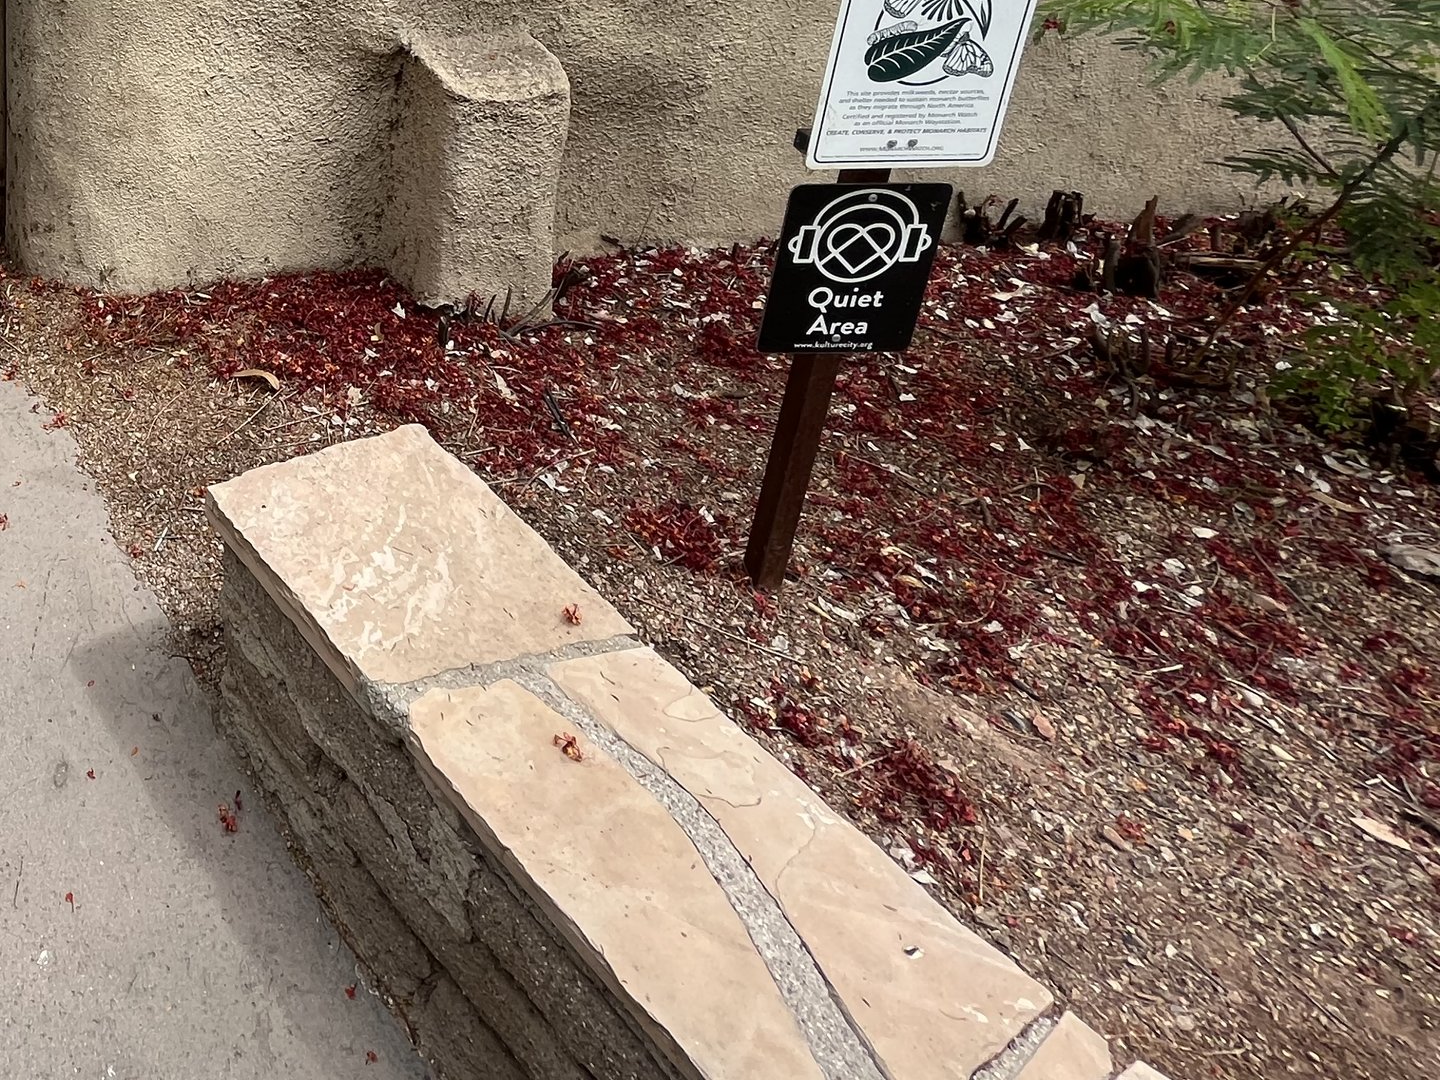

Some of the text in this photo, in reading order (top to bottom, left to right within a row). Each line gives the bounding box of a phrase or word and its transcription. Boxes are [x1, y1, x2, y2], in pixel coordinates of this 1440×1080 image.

[808, 287, 884, 313] Quiet
[806, 314, 868, 335] Area
[794, 341, 873, 350] www.kulturecity.org
